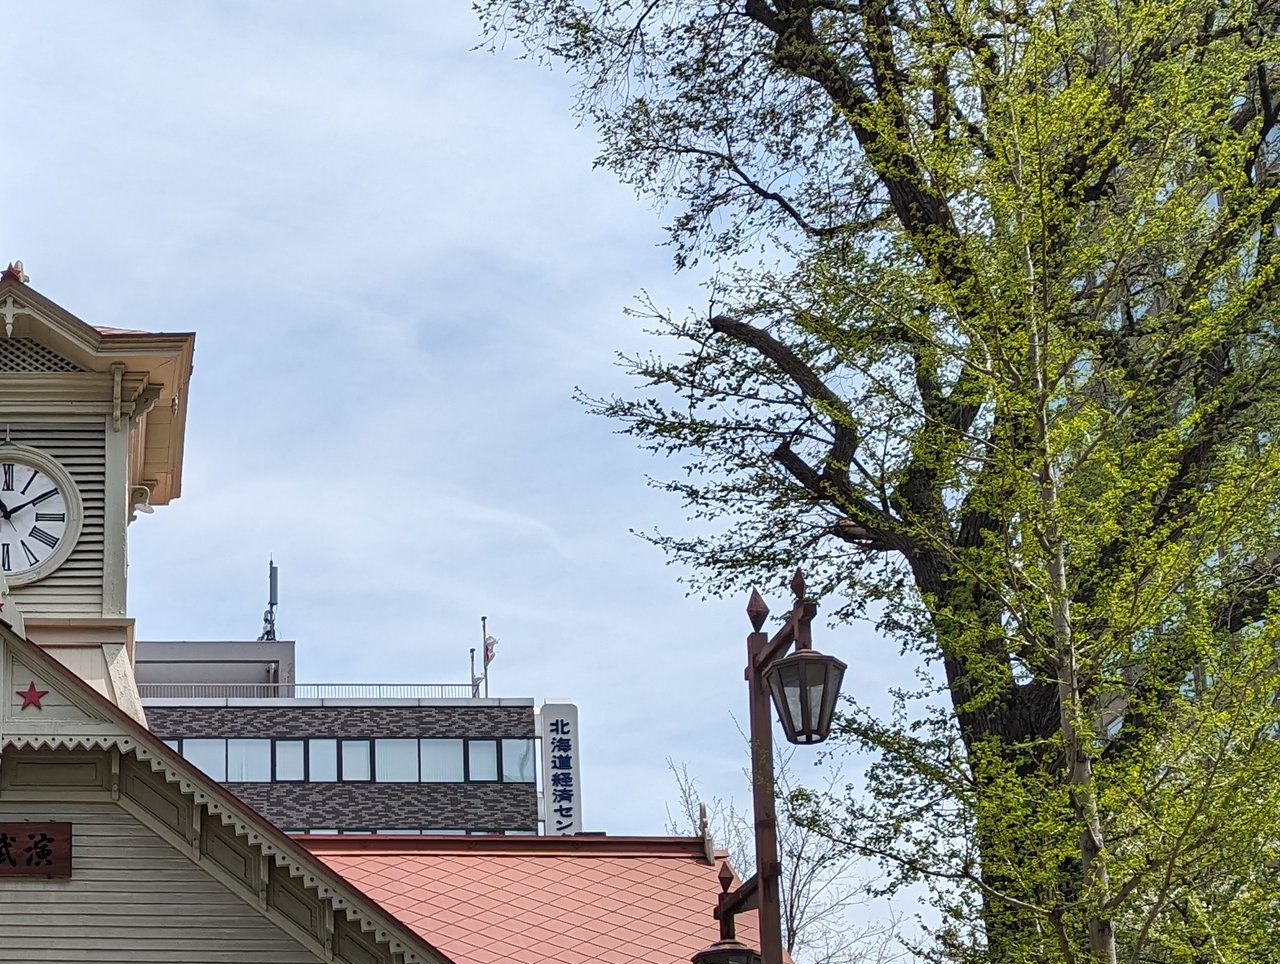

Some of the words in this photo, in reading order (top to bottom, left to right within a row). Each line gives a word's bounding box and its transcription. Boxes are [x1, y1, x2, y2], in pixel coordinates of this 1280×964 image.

[35, 512, 65, 522] III
[550, 719, 574, 836] 北海道経済セン
